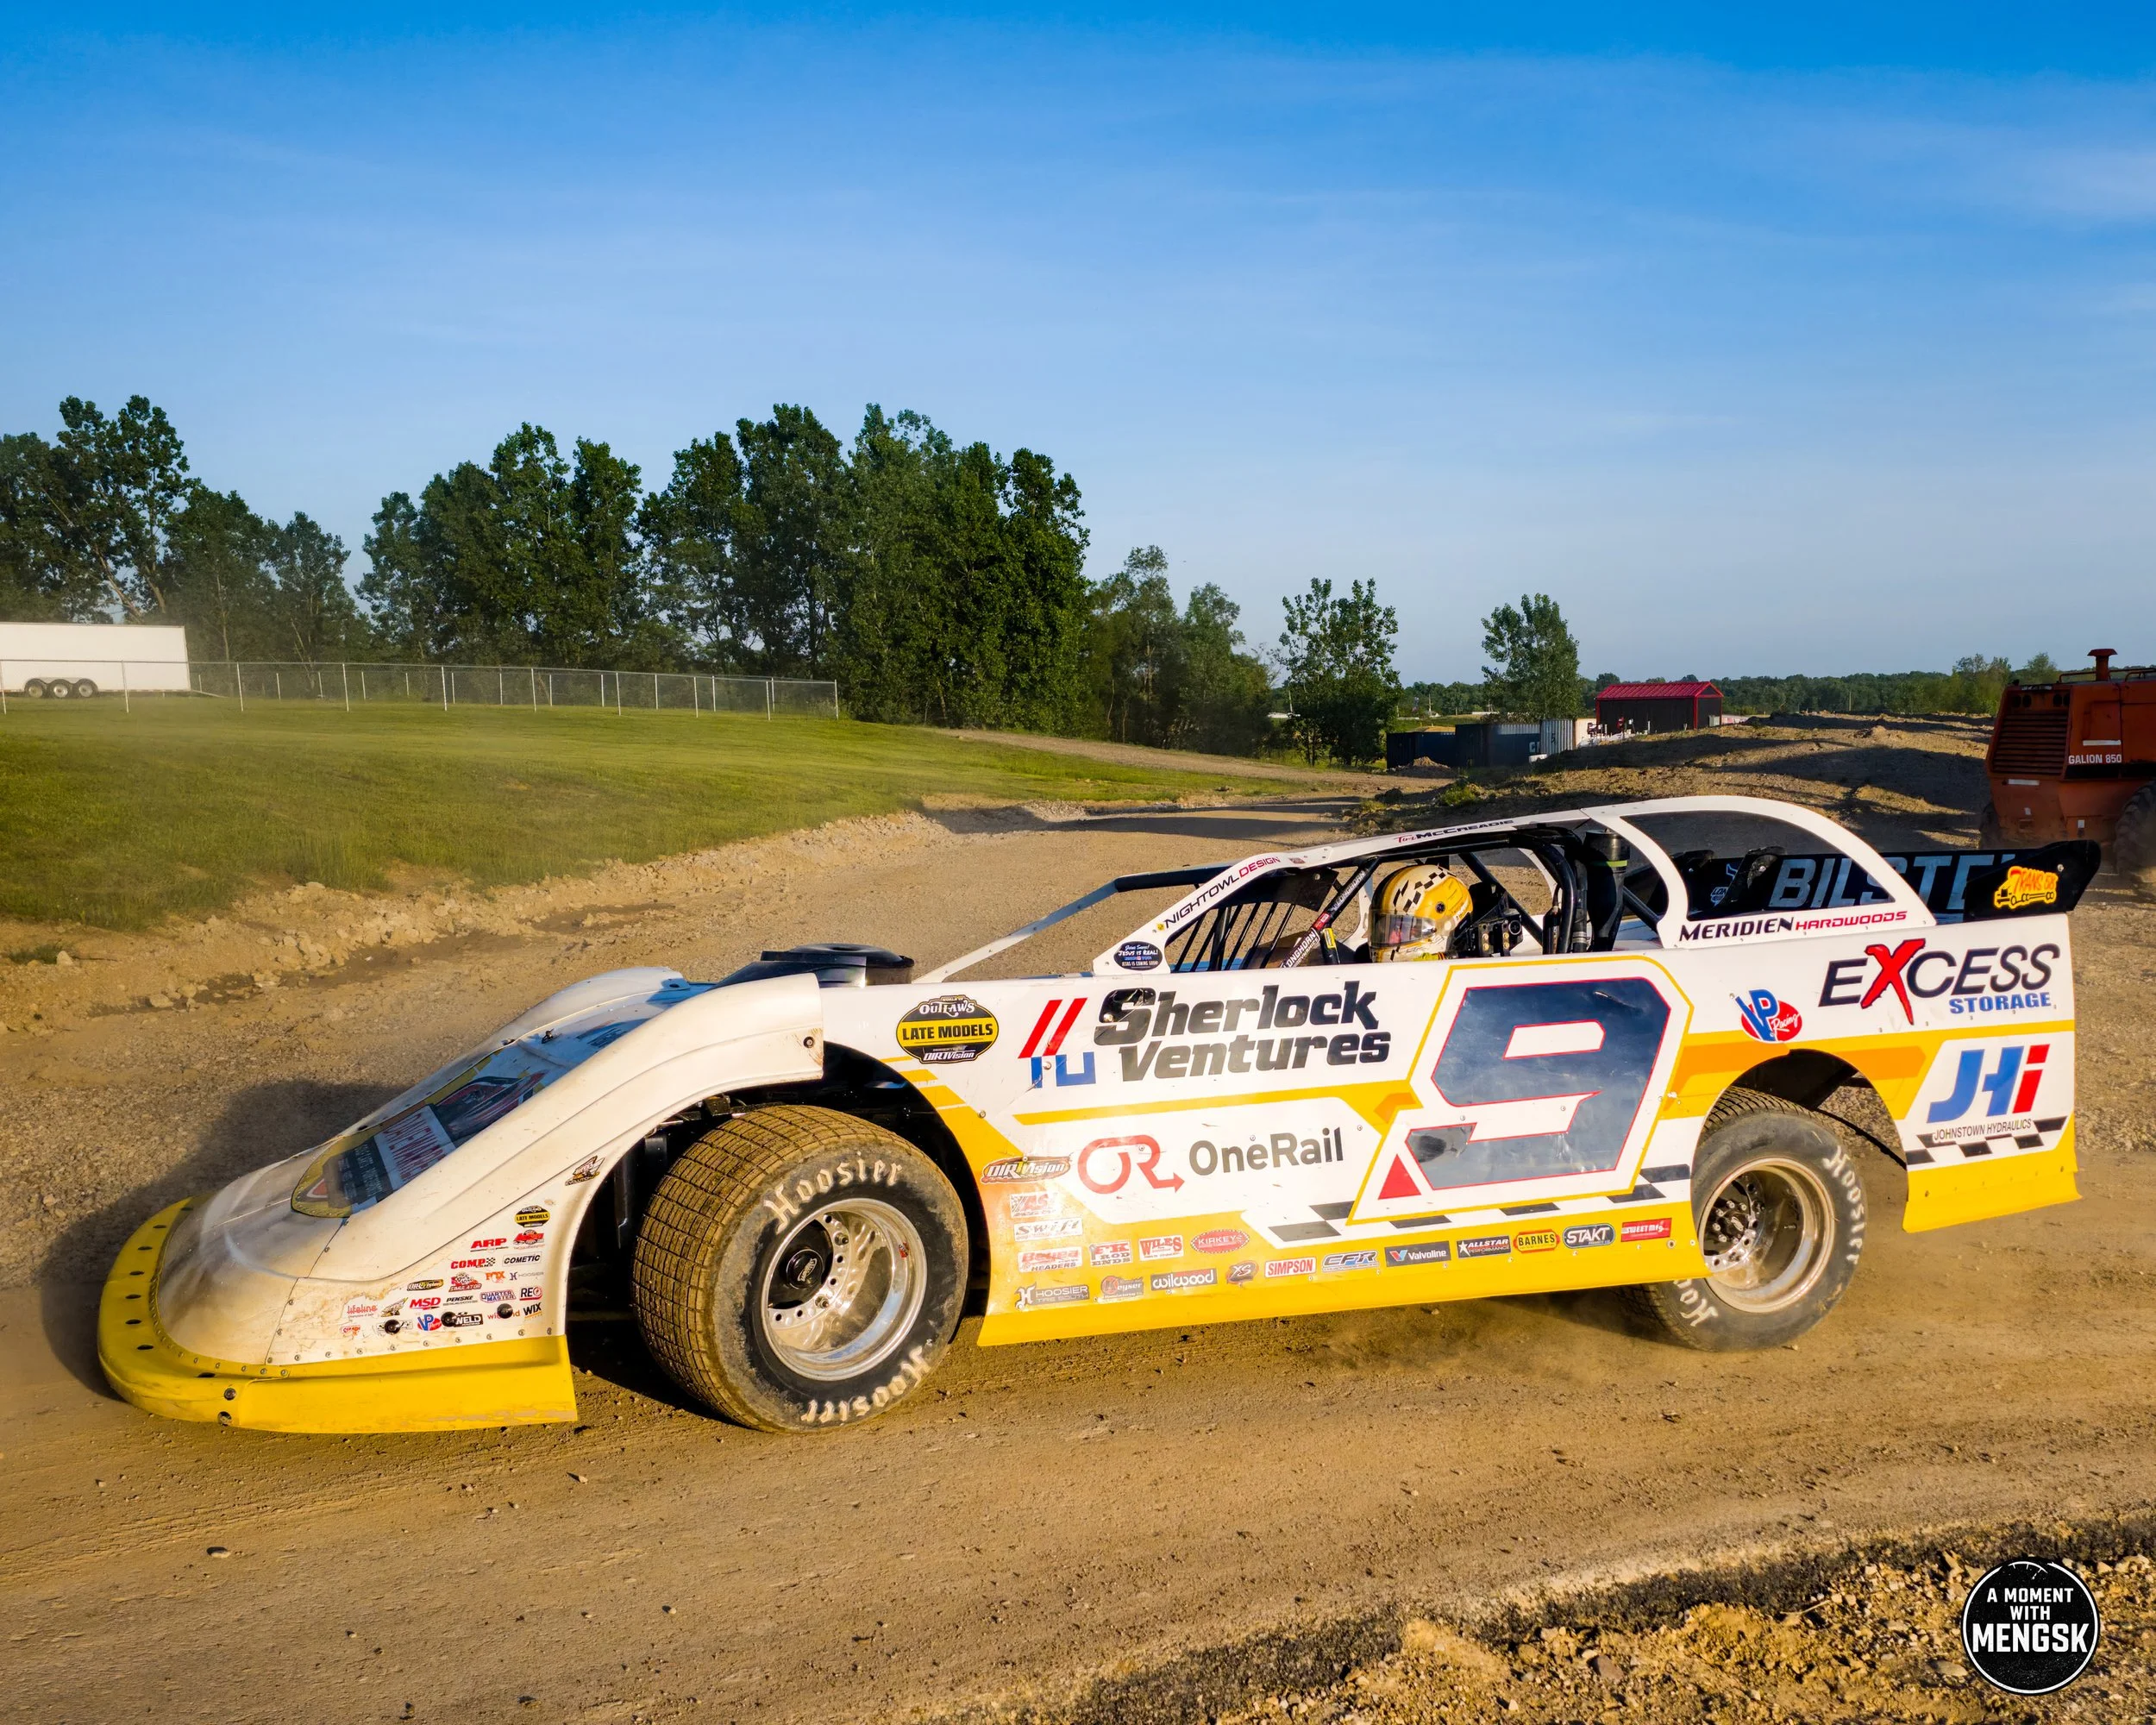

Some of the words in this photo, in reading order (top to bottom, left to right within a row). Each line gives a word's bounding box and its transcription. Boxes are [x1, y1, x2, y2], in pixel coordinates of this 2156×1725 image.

[2068, 755, 2103, 764] GALION
[2105, 754, 2122, 763] 850
[1337, 870, 1366, 908] LONGHORN
[2010, 869, 2044, 894] TRANS
[1679, 917, 1795, 942] MERIDIEN
[1796, 911, 1908, 931] HARDWOODS
[1283, 931, 1317, 967] ONGHORN
[1819, 938, 2060, 1025] EXCESS
[1949, 992, 2052, 1014] STORAGE
[1094, 981, 1379, 1045] Sherlock
[1735, 988, 1778, 1041] VP
[1771, 1013, 1800, 1032] Racing
[902, 1027, 935, 1040] LATE
[938, 1024, 993, 1038] MODELS
[1119, 1032, 1391, 1082] Ventures
[1405, 976, 1671, 1190] 9
[1934, 1124, 1985, 1140] JOHNSTOWN
[1986, 1119, 2032, 1134] HYDRAULICS
[1188, 1126, 1344, 1176] OneRail
[764, 1151, 902, 1234] Hoosier
[1821, 1145, 1866, 1264] Hoosier
[1566, 1226, 1610, 1244] STAKT
[1626, 1225, 1648, 1233] SWEET
[470, 1238, 507, 1249] ARP
[1140, 1237, 1182, 1256] WILES
[1198, 1235, 1237, 1245] KIRKEY
[1468, 1239, 1509, 1248] ALLSTAR
[1518, 1233, 1556, 1246] BARNES
[504, 1254, 541, 1264] COMETIC
[1324, 1251, 1378, 1266] CFR
[1407, 1249, 1447, 1260] Valvoline
[451, 1258, 486, 1269] COMP
[1031, 1262, 1076, 1271] HEADERS
[1228, 1264, 1251, 1279] XS
[1267, 1259, 1313, 1276] SIMPSON
[486, 1271, 505, 1281] FOX
[1152, 1270, 1214, 1289] wilwood
[481, 1291, 512, 1300] QUARTER
[1035, 1286, 1088, 1298] HOOSIER
[347, 1304, 378, 1314] lifeline
[410, 1297, 441, 1308] MSD
[523, 1302, 542, 1315] WIX
[417, 1314, 434, 1331] VP
